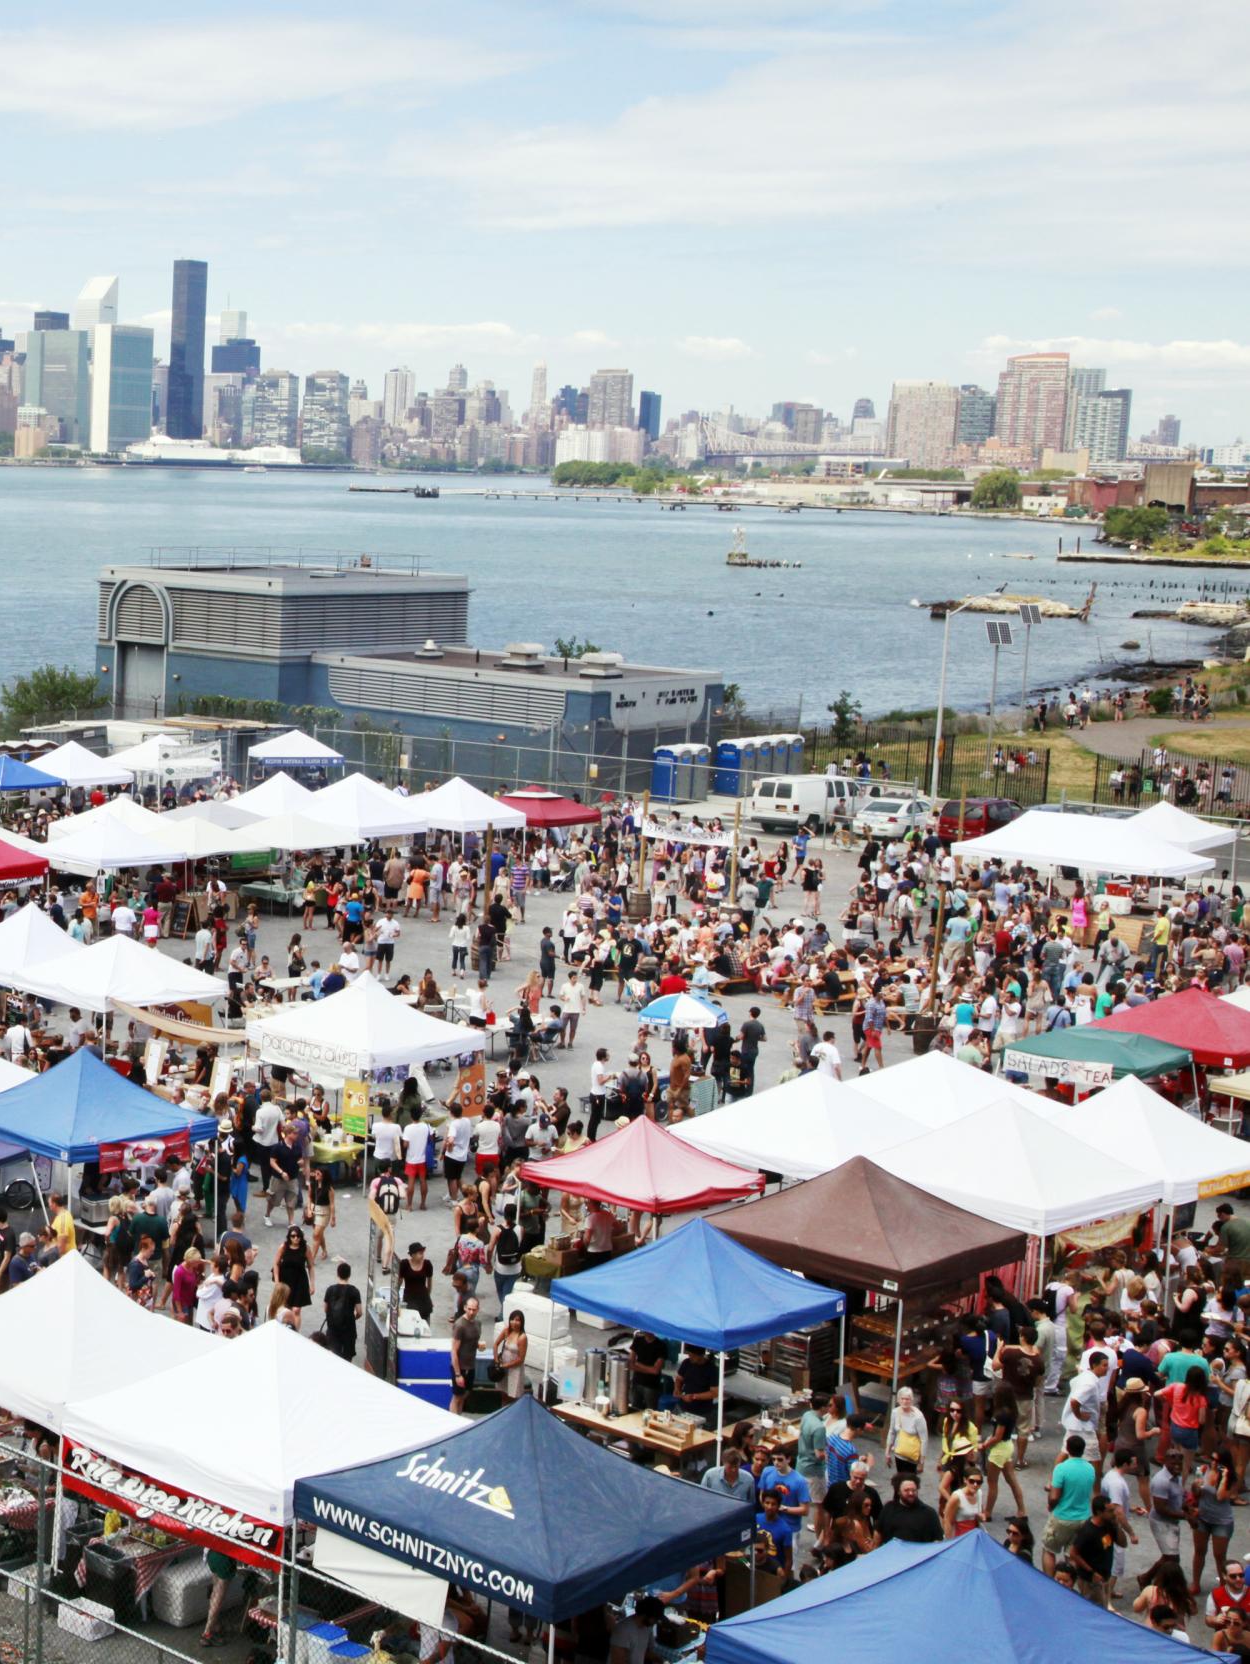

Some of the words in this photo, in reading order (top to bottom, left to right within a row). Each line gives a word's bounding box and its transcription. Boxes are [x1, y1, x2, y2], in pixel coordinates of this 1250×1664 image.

[1007, 1053, 1070, 1076] SALADS
[1084, 1069, 1111, 1084] TEA
[396, 1452, 515, 1520] Schnitz
[176, 1496, 274, 1548] Kitchen
[312, 1496, 534, 1606] WWW.SCHNITZNYC.COM
